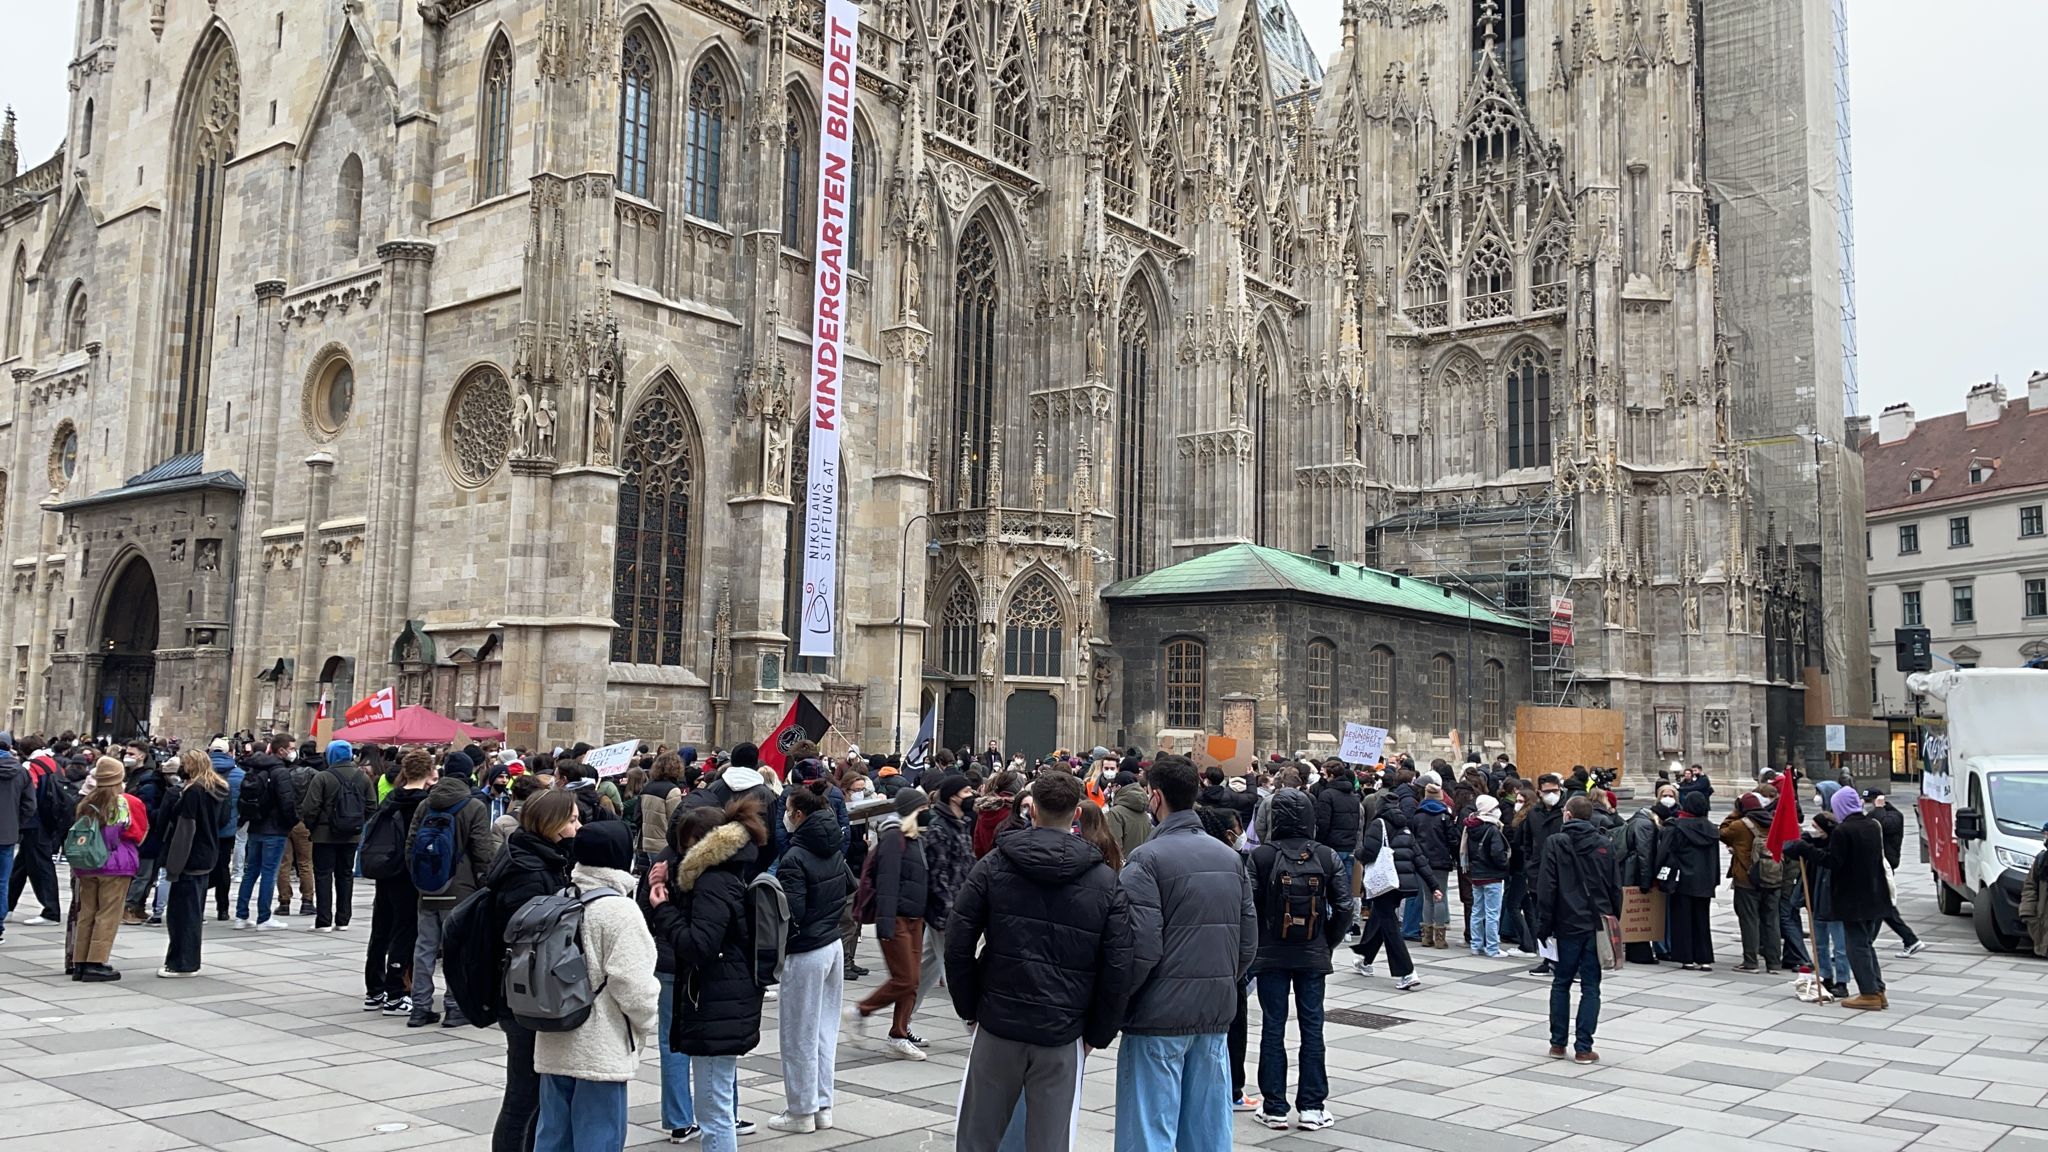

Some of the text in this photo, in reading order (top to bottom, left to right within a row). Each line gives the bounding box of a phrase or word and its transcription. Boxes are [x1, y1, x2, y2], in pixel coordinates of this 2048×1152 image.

[815, 15, 851, 431] KINDERGARTEN BILDET
[809, 482, 821, 560] NIKOLAUS
[821, 459, 834, 561] STIFTUNG.AT
[1346, 750, 1374, 759] LEISTUNG
